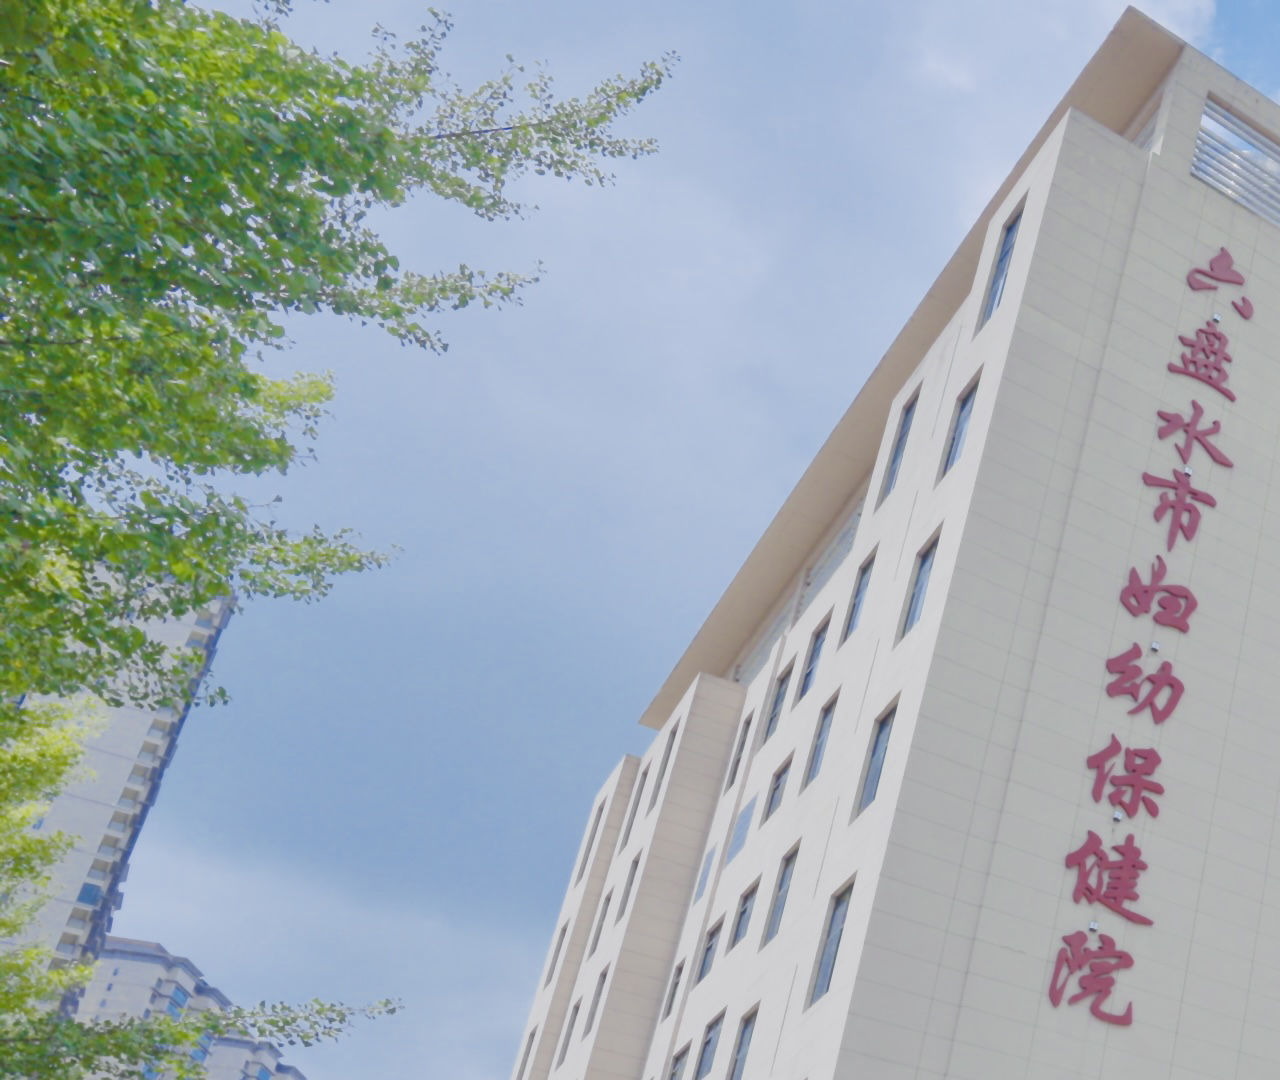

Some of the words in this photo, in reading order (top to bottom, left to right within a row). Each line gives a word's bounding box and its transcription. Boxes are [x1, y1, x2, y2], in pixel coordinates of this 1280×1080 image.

[1048, 247, 1254, 1027] 六盘水市妇幼保健院
